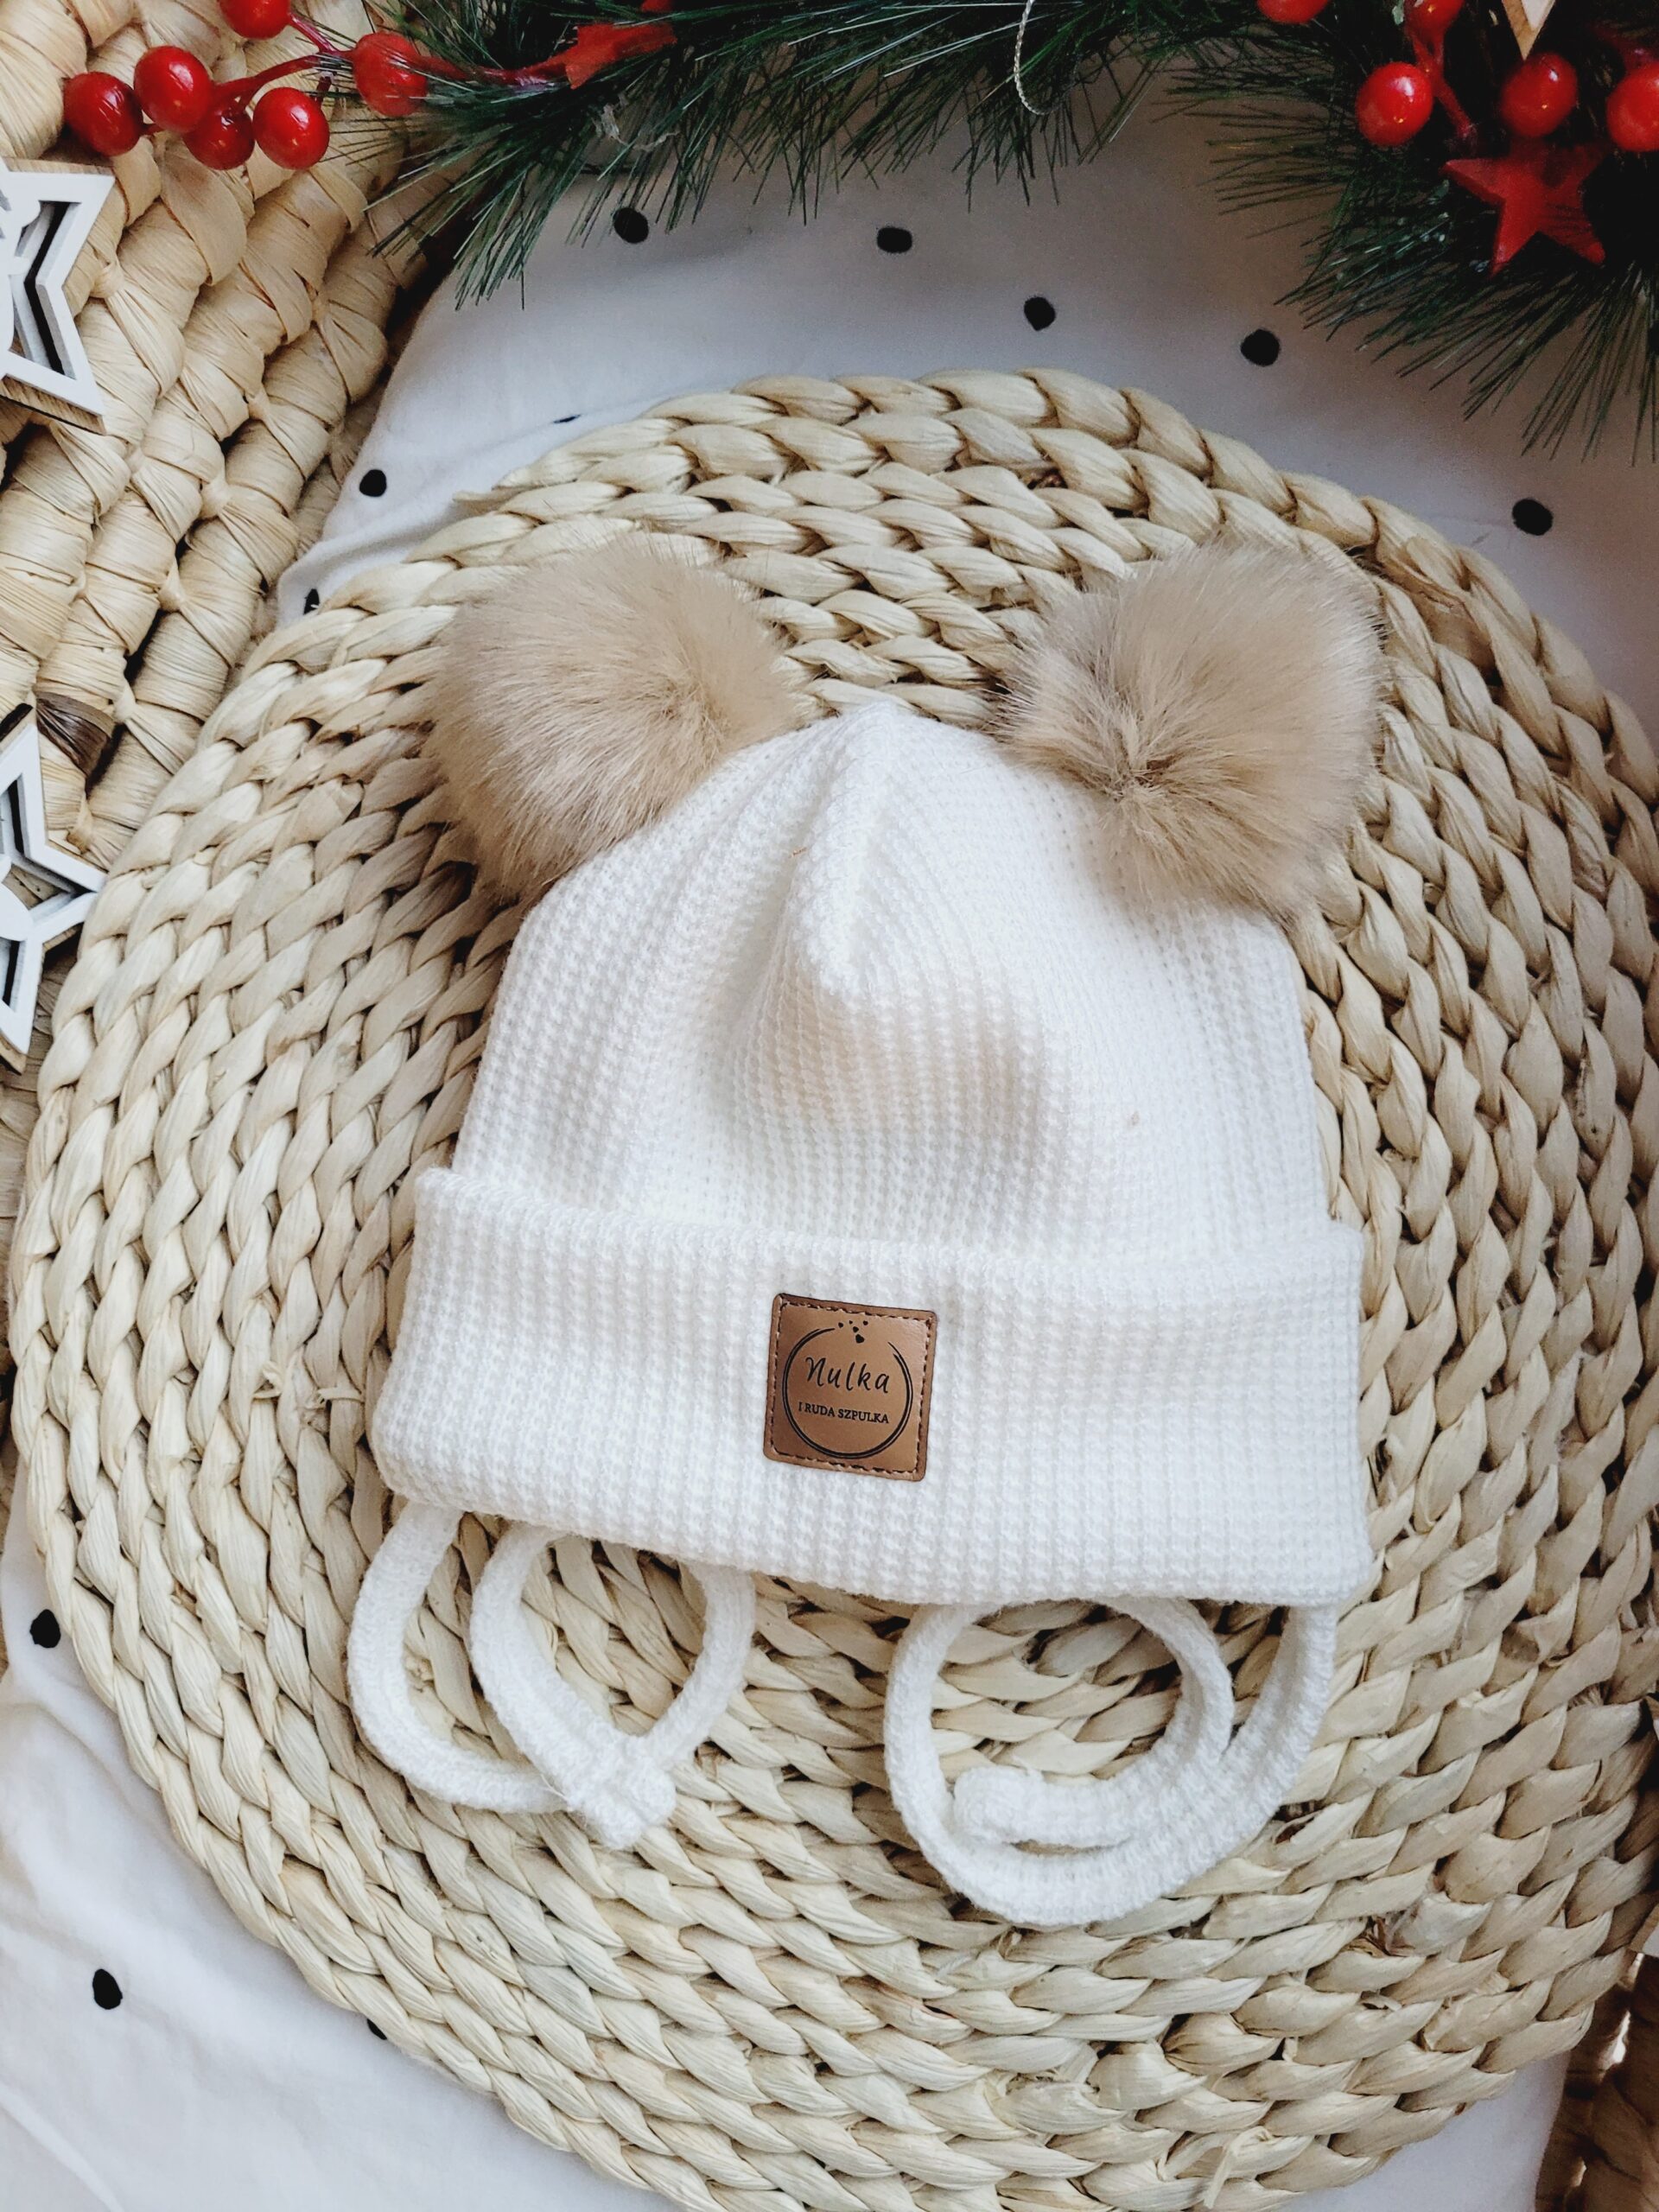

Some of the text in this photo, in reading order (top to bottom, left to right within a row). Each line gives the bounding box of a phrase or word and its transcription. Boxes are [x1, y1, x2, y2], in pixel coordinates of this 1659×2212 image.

[804, 1357, 890, 1394] Nulka
[798, 1402, 889, 1423] I RUDA SZPULKA
